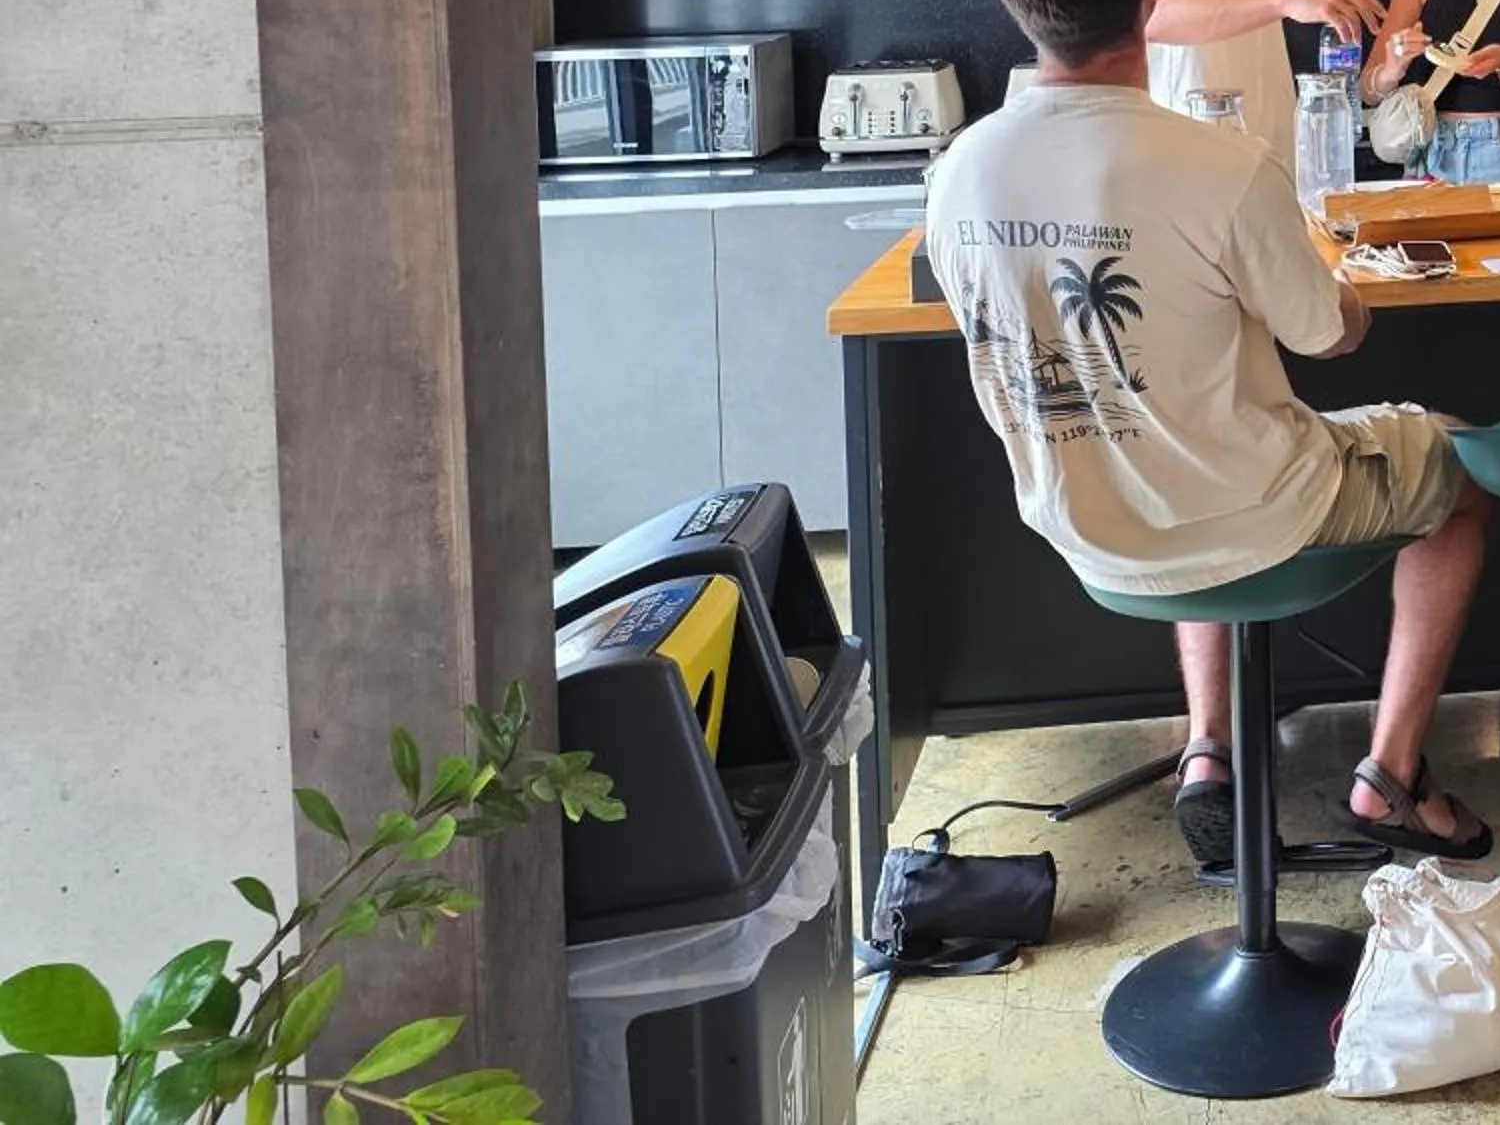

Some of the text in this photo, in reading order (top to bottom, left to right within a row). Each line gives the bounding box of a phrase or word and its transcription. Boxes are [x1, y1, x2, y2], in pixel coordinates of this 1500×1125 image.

[957, 219, 1061, 248] EL NIDO
[1065, 223, 1134, 241] PALAWAN
[1063, 237, 1132, 252] PHILIPPINES
